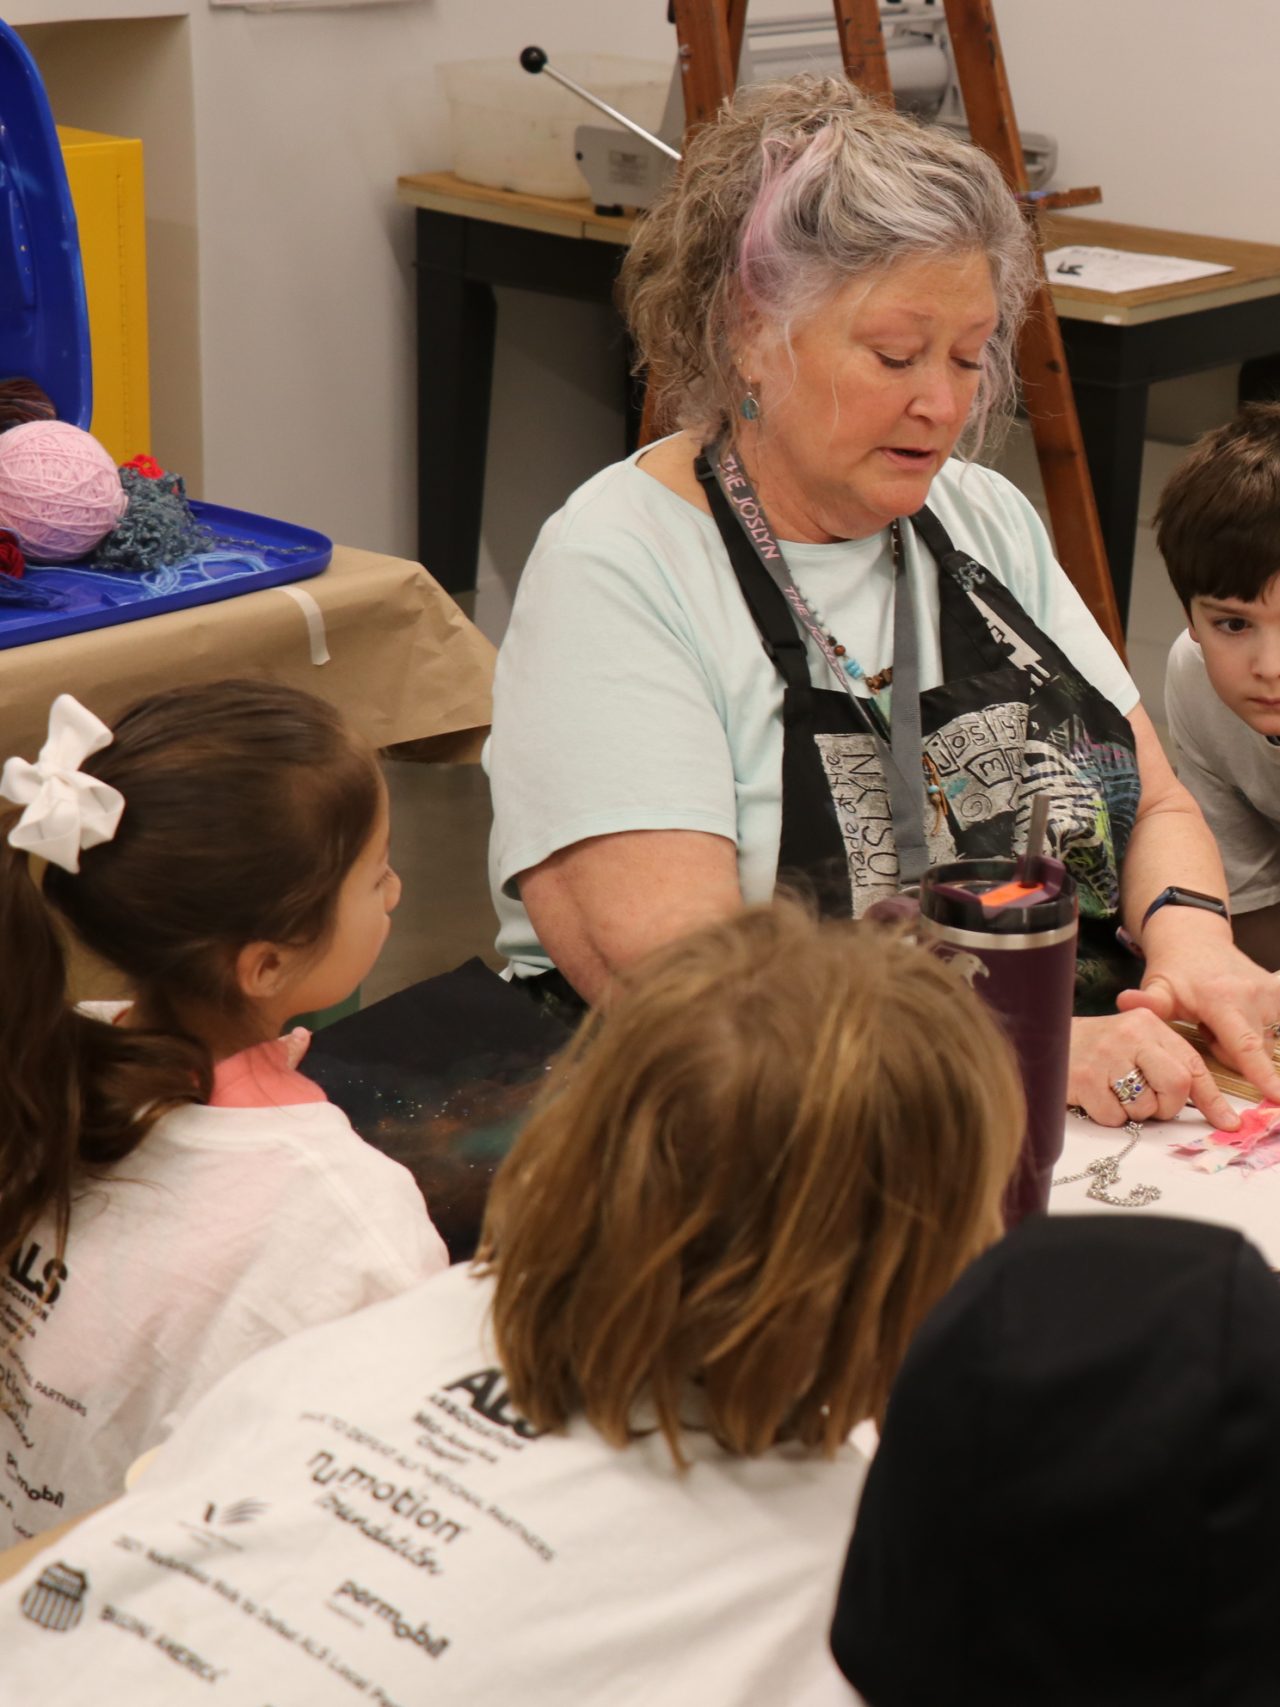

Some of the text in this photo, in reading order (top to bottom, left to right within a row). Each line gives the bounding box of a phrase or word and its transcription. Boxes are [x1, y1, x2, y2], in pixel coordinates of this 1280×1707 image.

[717, 453, 780, 560] THE JOSLYN
[784, 585, 848, 688] THE JOSLYN
[826, 754, 869, 887] made at the
[34, 1380, 88, 1418] PARTNERS
[333, 1579, 450, 1661] permobil
